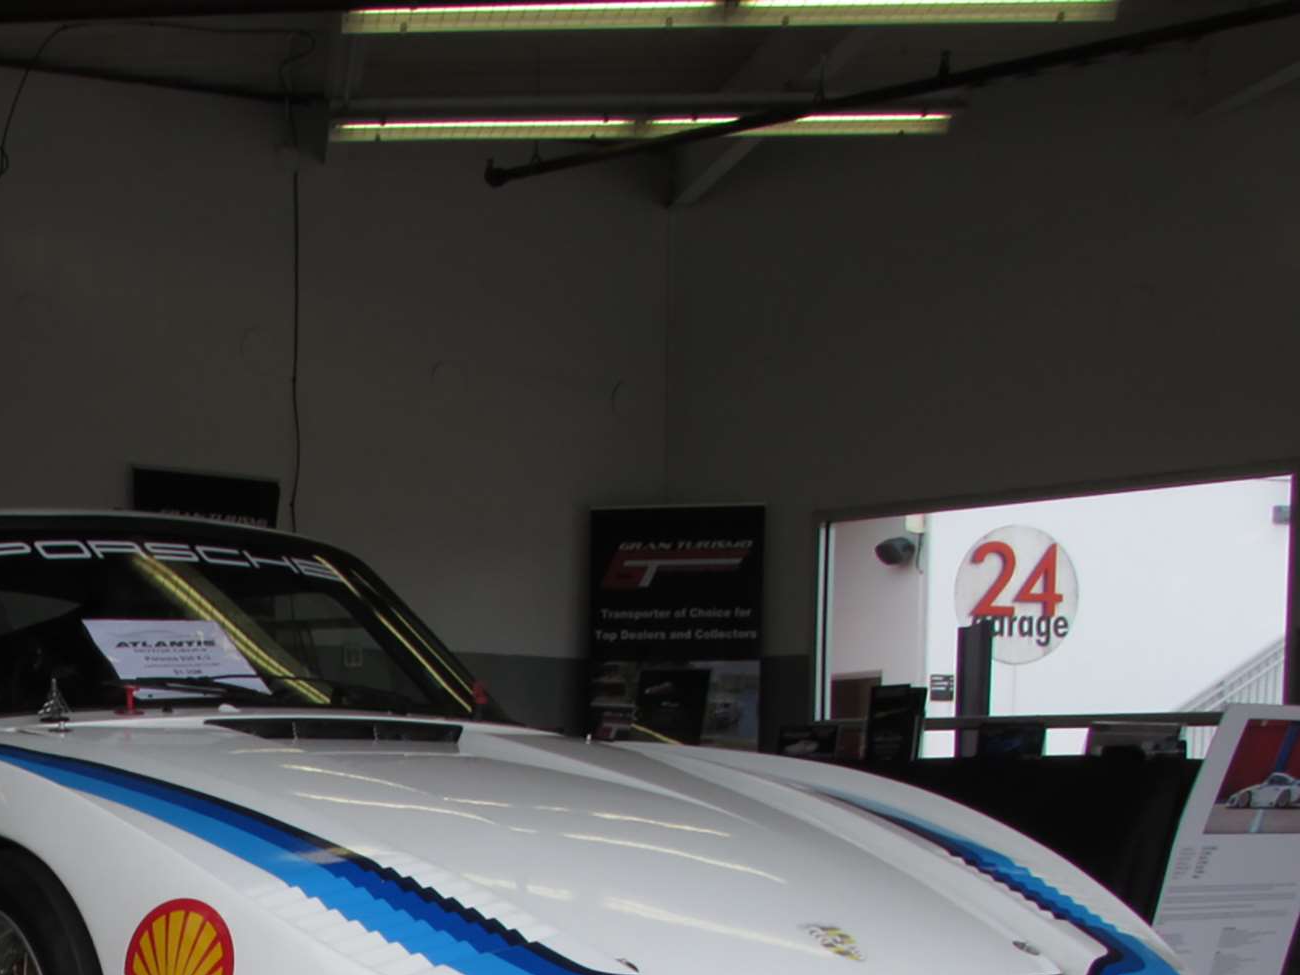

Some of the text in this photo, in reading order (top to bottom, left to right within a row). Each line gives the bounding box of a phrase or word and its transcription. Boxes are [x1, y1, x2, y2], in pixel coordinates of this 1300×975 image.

[969, 541, 1063, 617] 24
[600, 607, 752, 621] Transporter of Choice for
[595, 628, 758, 642] Top Dealers and Collectors
[973, 615, 1069, 646] arage
